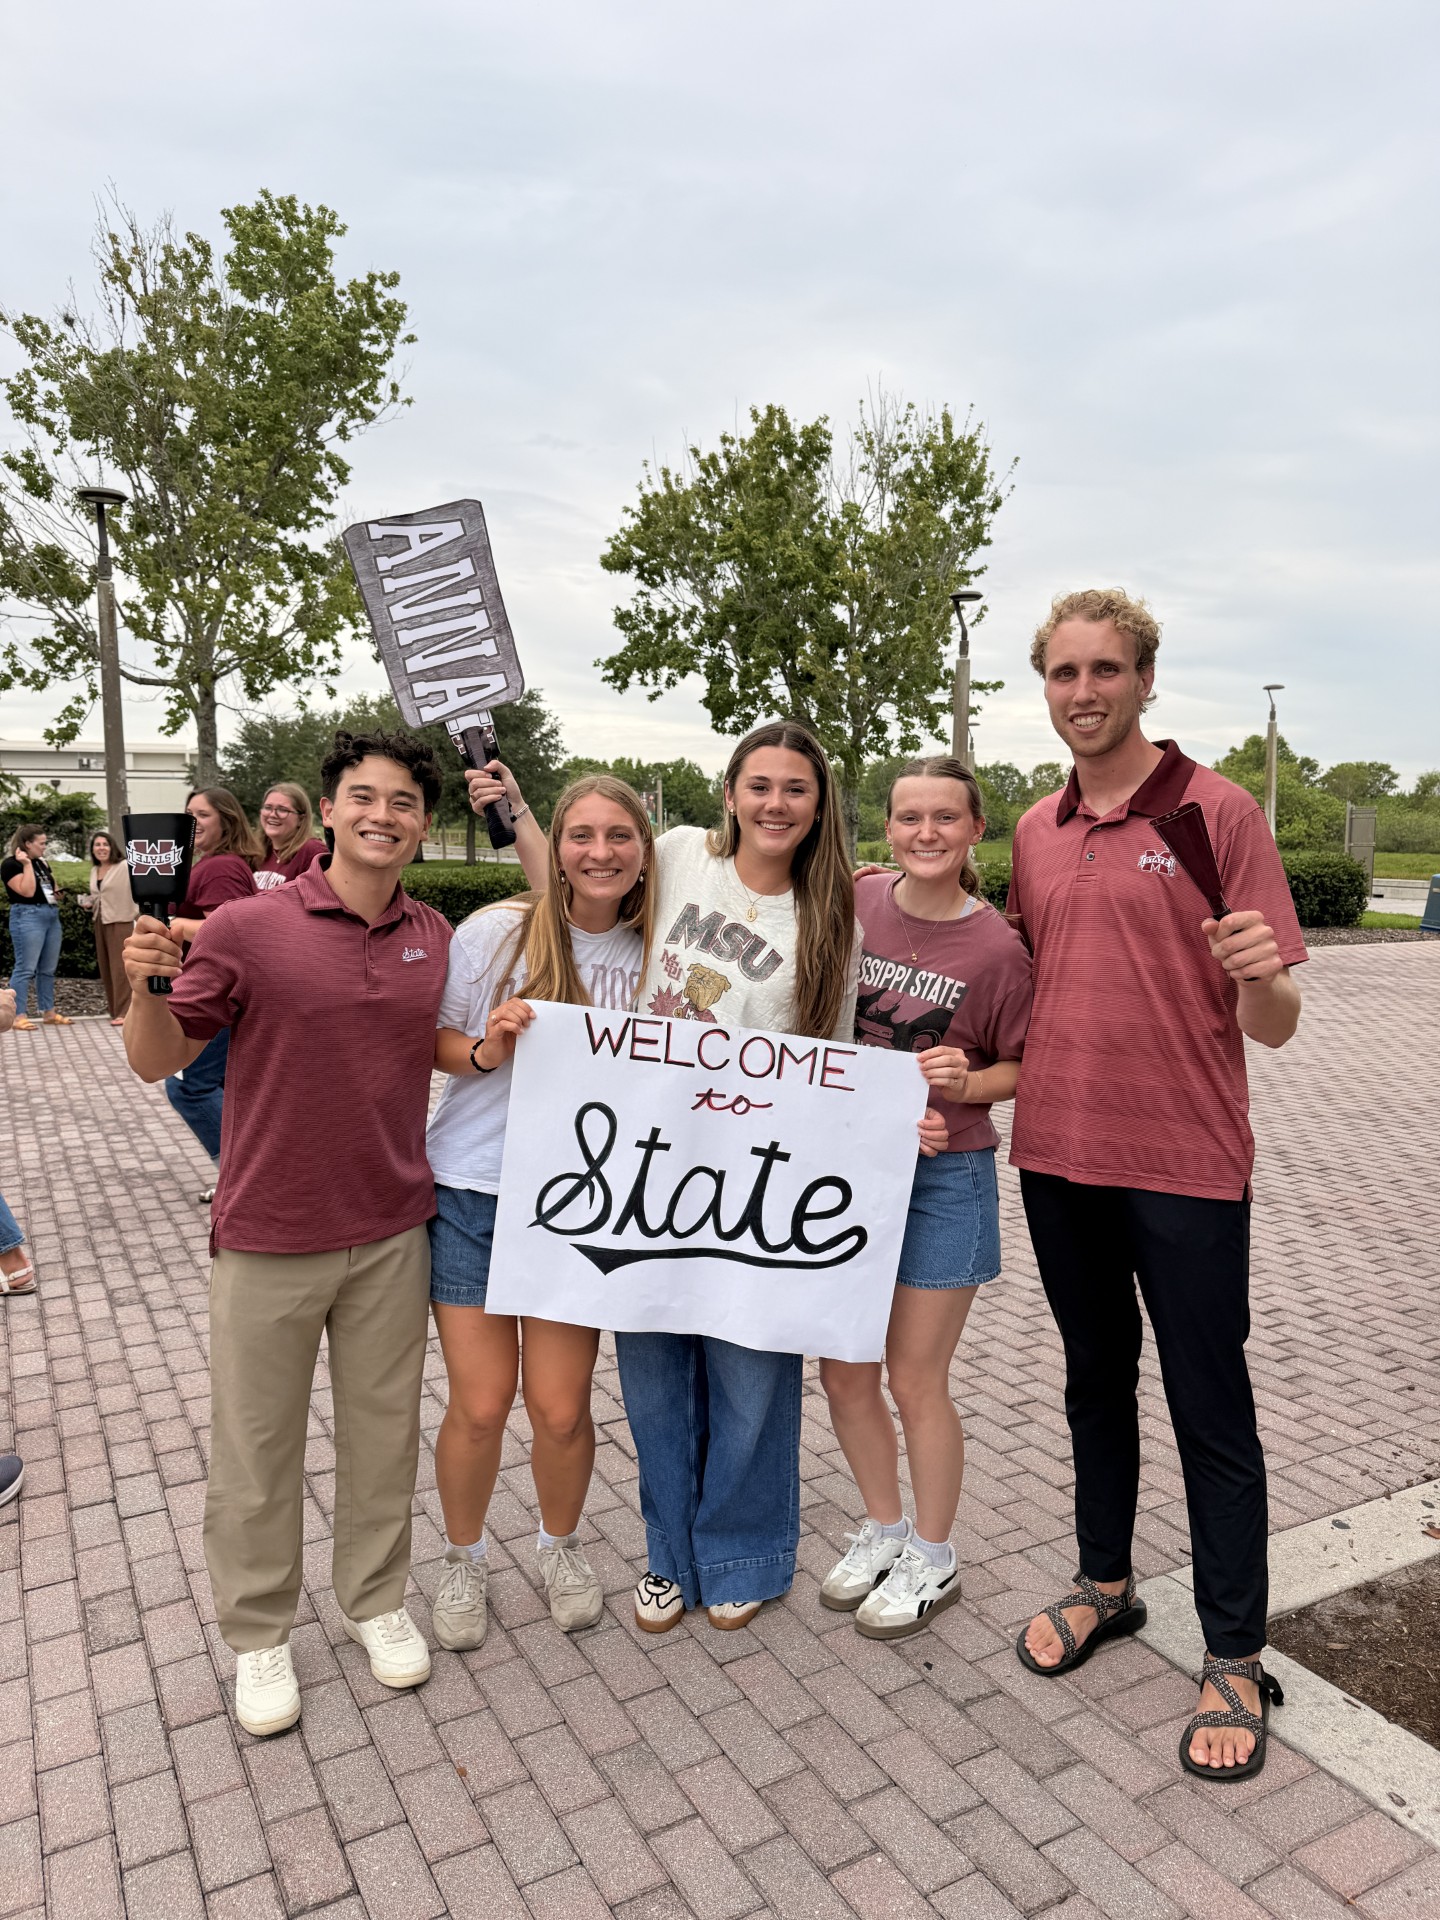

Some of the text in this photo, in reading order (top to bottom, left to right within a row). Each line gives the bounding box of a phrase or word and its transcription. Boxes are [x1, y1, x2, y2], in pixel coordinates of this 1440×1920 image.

[366, 519, 509, 724] ANNA
[136, 853, 171, 864] STATE
[402, 947, 428, 962] State
[665, 902, 784, 982] MSU
[857, 954, 967, 1010] SSIPPI STATE
[584, 1012, 858, 1092] WELCOME
[690, 1087, 774, 1116] to
[526, 1101, 869, 1276] State
